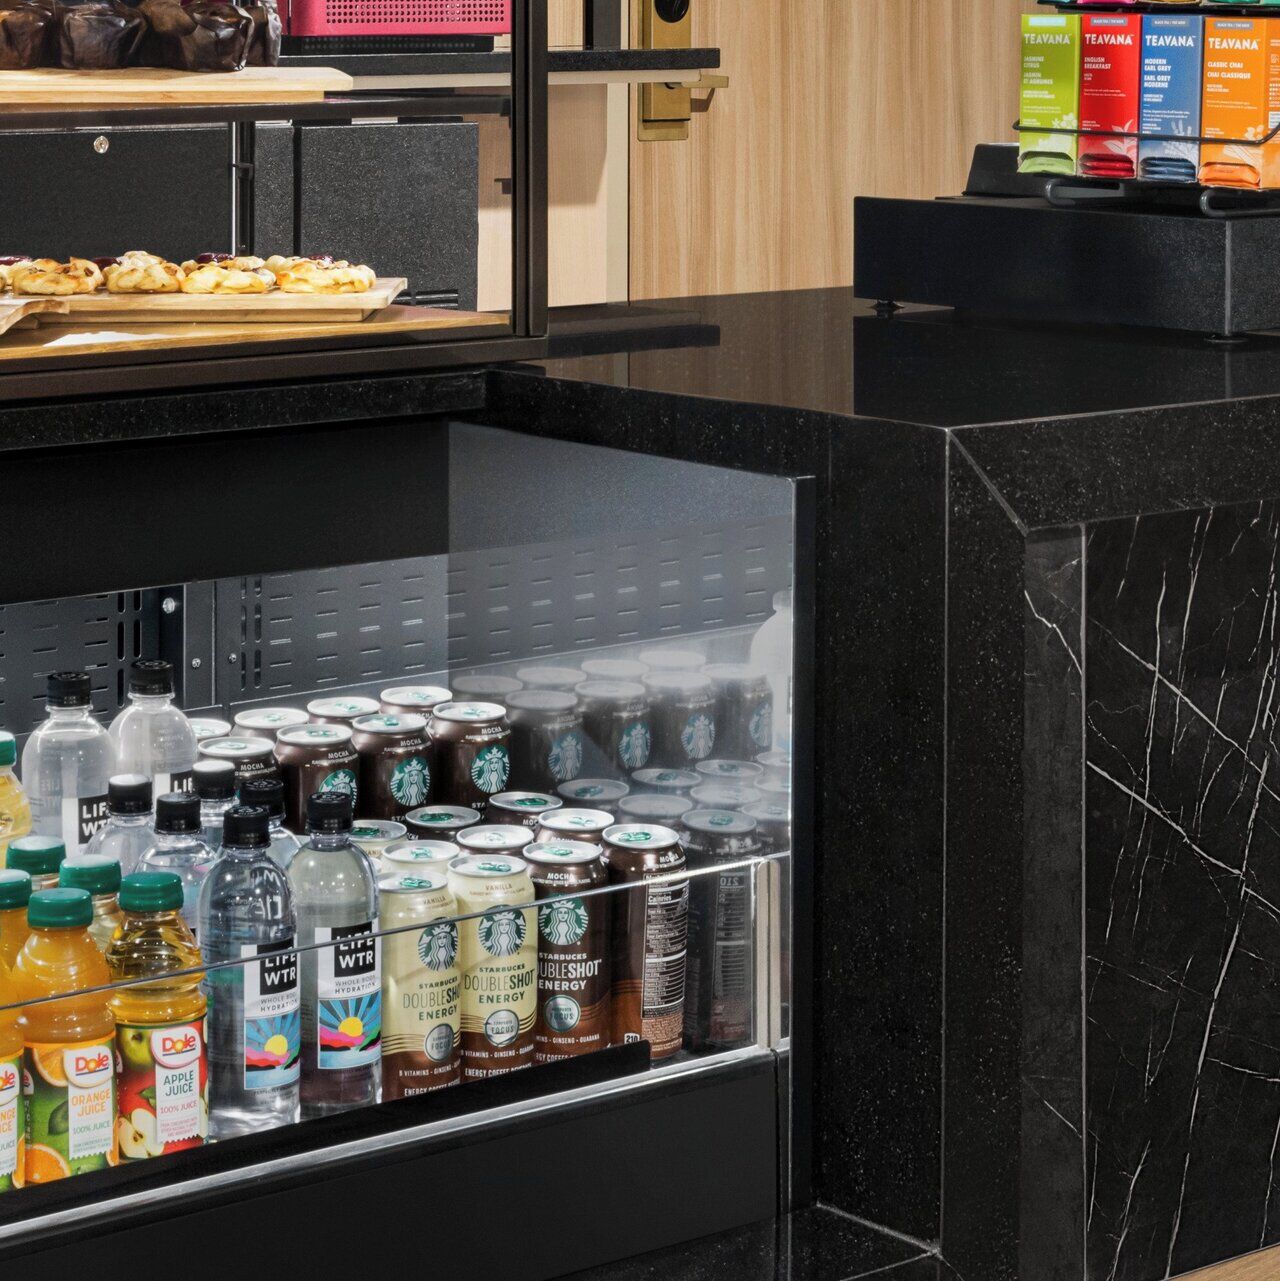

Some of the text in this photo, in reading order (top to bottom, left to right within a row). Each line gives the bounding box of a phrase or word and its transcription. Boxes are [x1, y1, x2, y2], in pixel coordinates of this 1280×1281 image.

[1024, 34, 1071, 45] TEAVANA
[1085, 34, 1133, 46] TEAVANA
[1145, 35, 1194, 47] TEAVANA
[1208, 37, 1259, 50] TEAVANA
[480, 726, 503, 735] MOCHA
[400, 738, 422, 747] MOCHA
[328, 750, 349, 759] MOCHA
[240, 762, 265, 771] MOCHA
[547, 872, 575, 880] MOCHA
[485, 883, 513, 891] VANILLA
[423, 896, 446, 905] VANILLA
[339, 950, 374, 969] WTR
[539, 952, 587, 961] STARBUCKS
[479, 963, 525, 973] STARBUCKS
[264, 967, 296, 986] WTR
[464, 968, 535, 992] DOUBLESHOT
[335, 979, 360, 987] WHOLE
[419, 976, 458, 989] STARBUCKS
[538, 980, 587, 991] ENERGY
[335, 983, 376, 994] HYDRATION
[260, 994, 285, 1005] WHOLE
[479, 991, 525, 1004] ENERGY
[418, 1005, 457, 1021] ENERGY
[491, 1025, 515, 1035] FOCUS
[162, 1033, 196, 1054] Dole
[626, 1035, 638, 1043] 210
[465, 1050, 489, 1058] VITAMINS
[494, 1049, 516, 1058] GINSENG
[75, 1052, 109, 1073] Dole
[163, 1070, 194, 1085] APPLE
[404, 1069, 429, 1077] VITAMINS
[465, 1067, 487, 1077] ENERGY
[165, 1081, 193, 1096] JUICE
[71, 1088, 110, 1106] ORANGE
[77, 1102, 106, 1117] JUICE
[160, 1099, 197, 1115] 100% JUICE
[73, 1120, 110, 1135] 100% JUICE
[0, 1140, 16, 1152] JUICE
